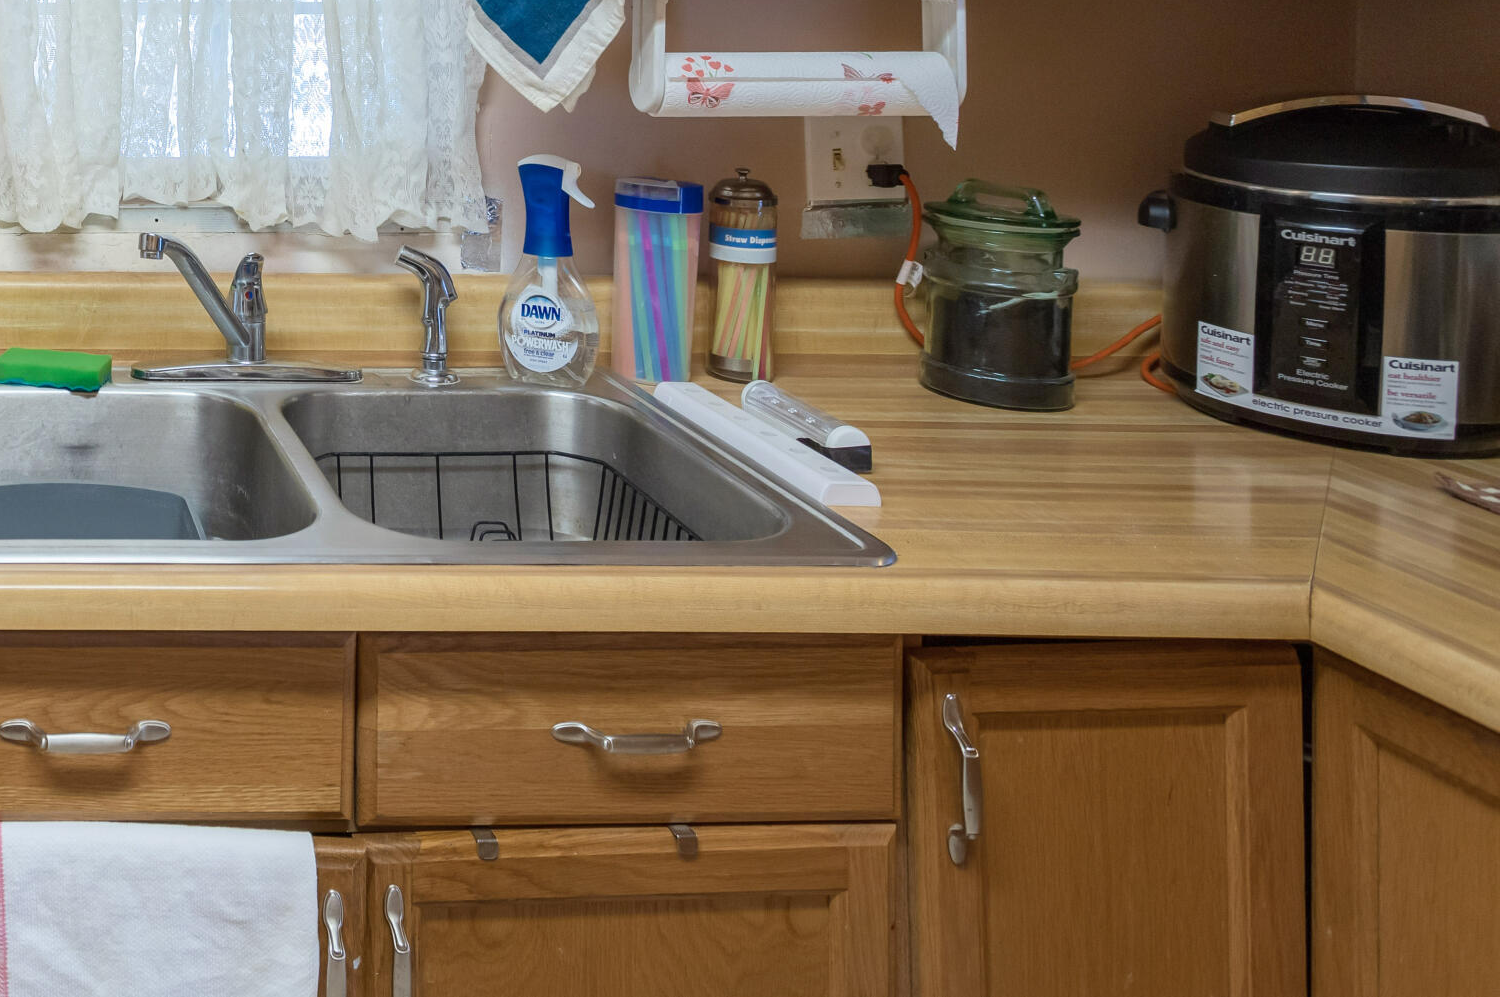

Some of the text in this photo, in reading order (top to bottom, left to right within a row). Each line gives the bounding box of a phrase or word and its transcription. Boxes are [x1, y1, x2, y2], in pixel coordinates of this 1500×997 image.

[724, 234, 748, 244] Straw
[1280, 229, 1356, 247] Cuisinart
[521, 303, 561, 322] DAWN
[523, 329, 556, 338] PLATINUM
[1200, 325, 1252, 346] Cuisinart
[511, 334, 570, 353] POWERWASH
[1295, 368, 1330, 380] Electric
[1388, 359, 1456, 373] Cuisinart
[1277, 373, 1349, 391] Pressure Cooker
[1252, 398, 1382, 428] electric pressure cooker
